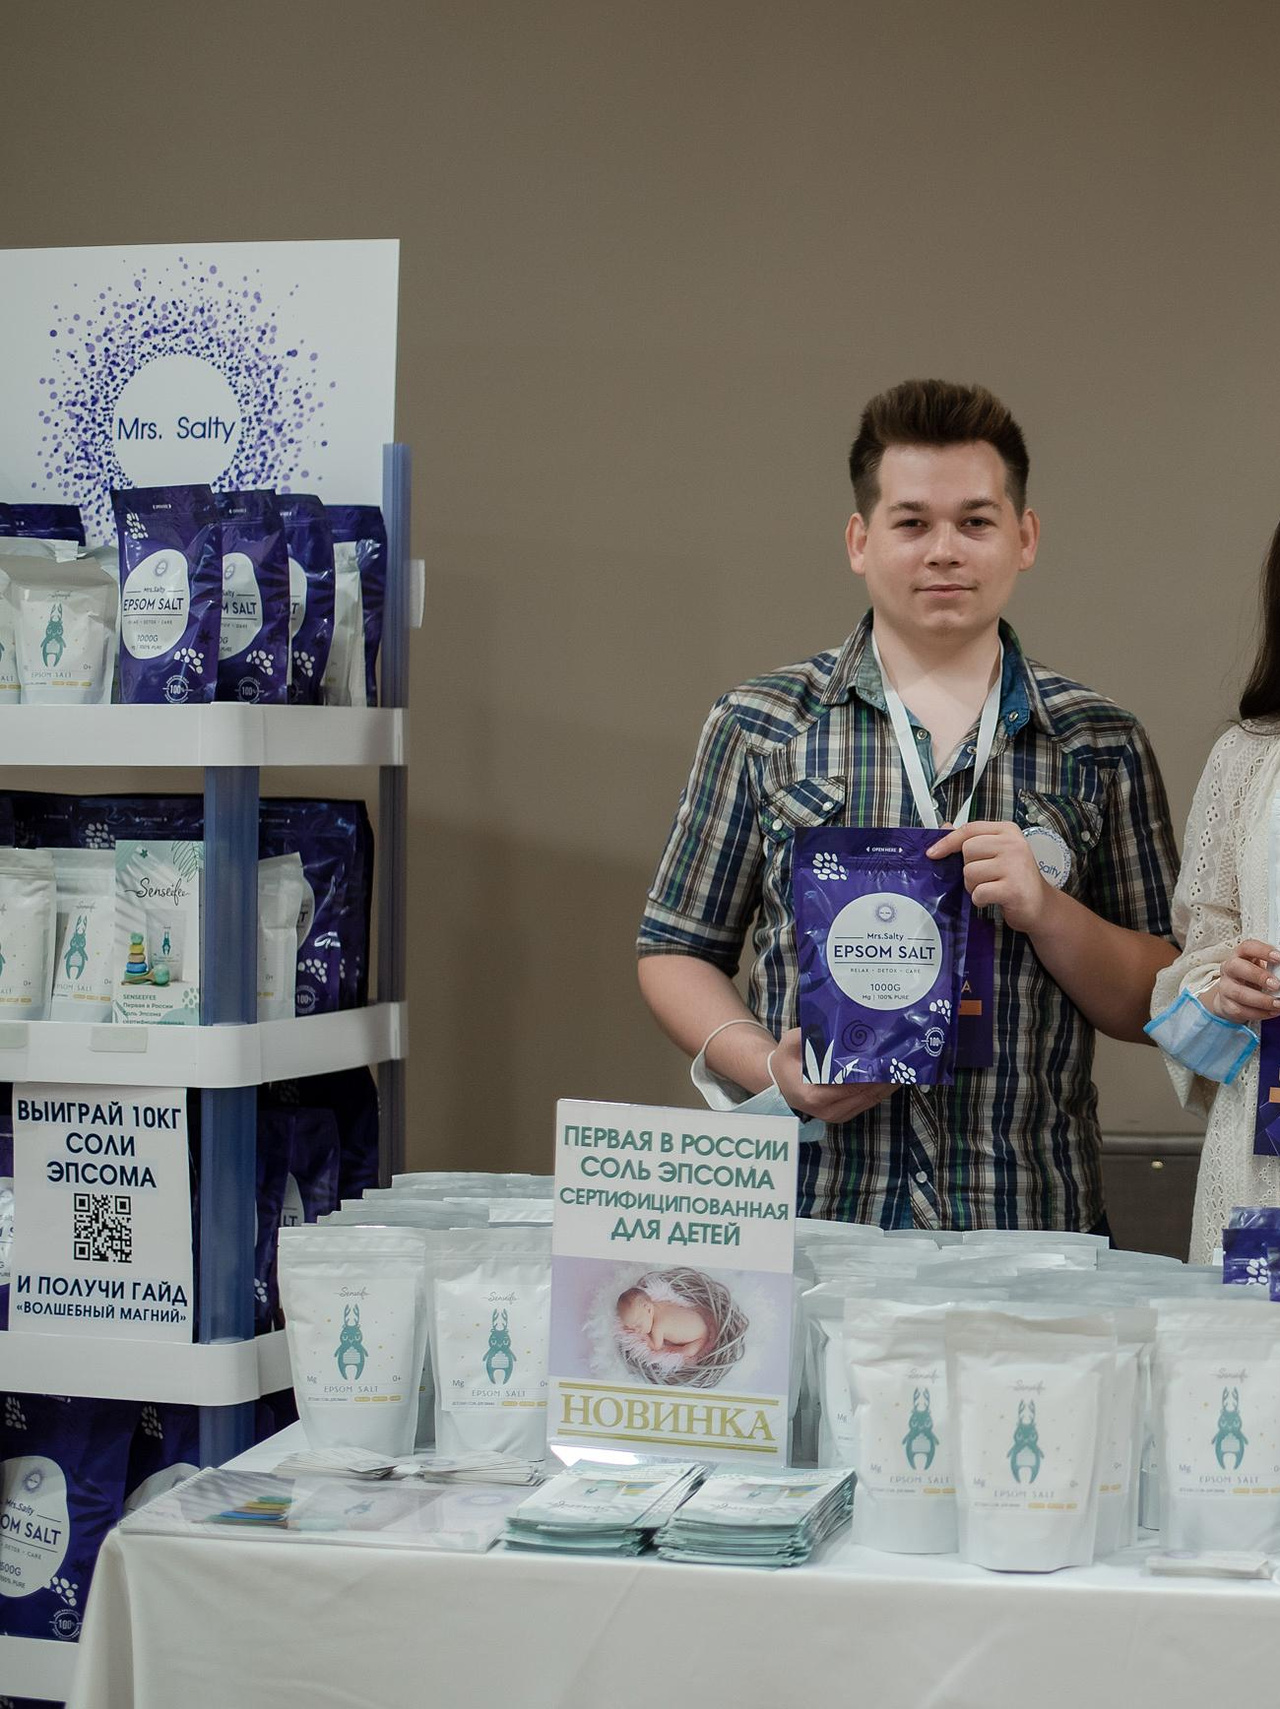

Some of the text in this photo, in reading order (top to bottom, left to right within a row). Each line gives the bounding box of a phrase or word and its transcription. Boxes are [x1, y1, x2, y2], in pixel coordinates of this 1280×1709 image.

[117, 416, 237, 444] Mrs. Salty
[123, 598, 184, 611] EPSOM SALT
[232, 602, 257, 615] SALT
[1038, 860, 1061, 879] Salty
[867, 932, 904, 941] Mrs.Salty
[834, 945, 936, 960] EPSOM SALT
[870, 983, 901, 992] 1000G
[17, 1099, 182, 1130] ВЫИГРАЙ 10КГ
[65, 1131, 136, 1157] СОЛИ
[564, 1124, 789, 1161] ПЕРВАЯ В РОССИИ
[46, 1161, 157, 1188] ЭПСОМА
[580, 1155, 775, 1190] СОЛЬ ЭПСОМА
[611, 1216, 741, 1246] ДЛЯ ДЕТЕЙ
[17, 1275, 188, 1307] И ПОЛУЧИ ГАЙД
[16, 1301, 187, 1323] «ВОЛШЕБНЫЙ МАГНИЙ»
[324, 1385, 378, 1393] EPSOM SALT
[471, 1389, 526, 1397] EPSOM SALT
[560, 1393, 778, 1441] НОВИНКА
[24, 1521, 61, 1545] SALT
[0, 1562, 21, 1577] 500G
